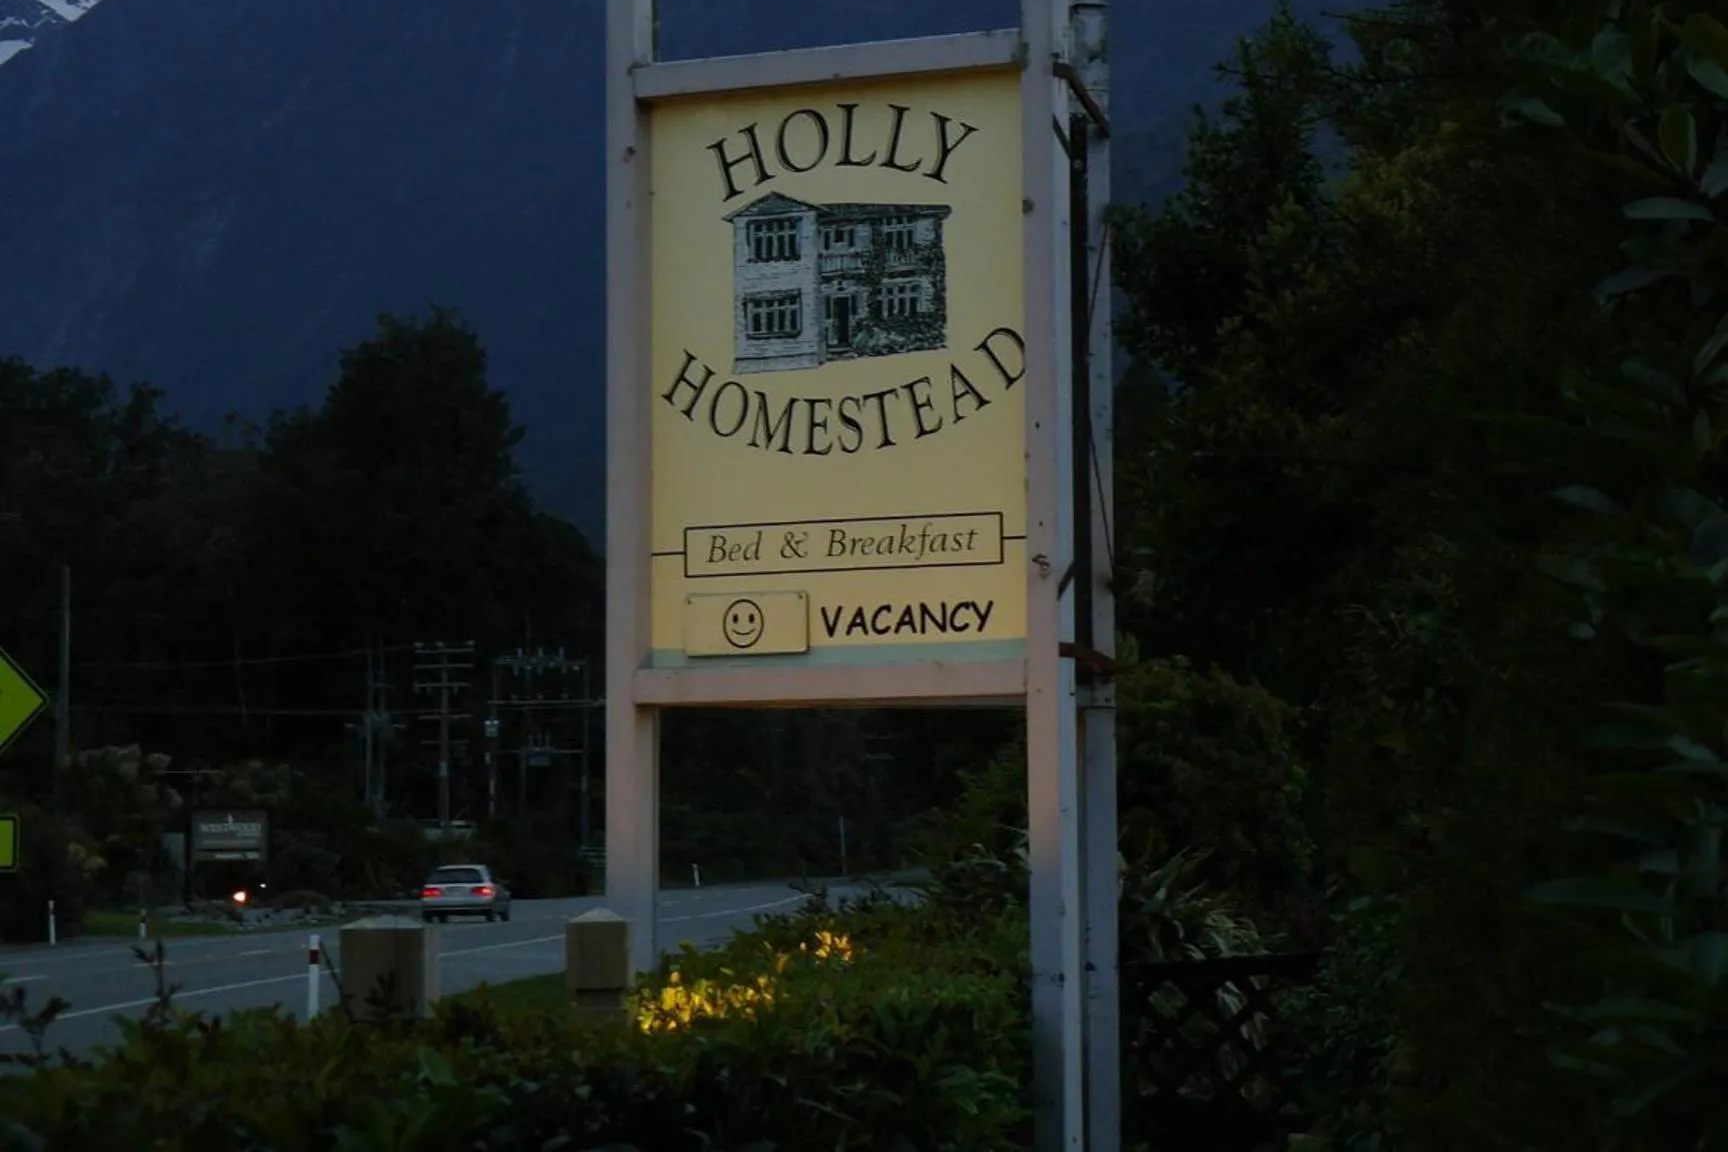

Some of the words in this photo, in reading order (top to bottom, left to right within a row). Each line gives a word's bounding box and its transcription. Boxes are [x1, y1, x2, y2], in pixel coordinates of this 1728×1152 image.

[706, 103, 979, 202] HOLLY
[661, 327, 1025, 456] HOMESTEAD
[706, 530, 763, 563] Bed
[780, 531, 808, 560] &
[825, 523, 978, 560] Breakfast
[820, 600, 994, 638] VACANCY
